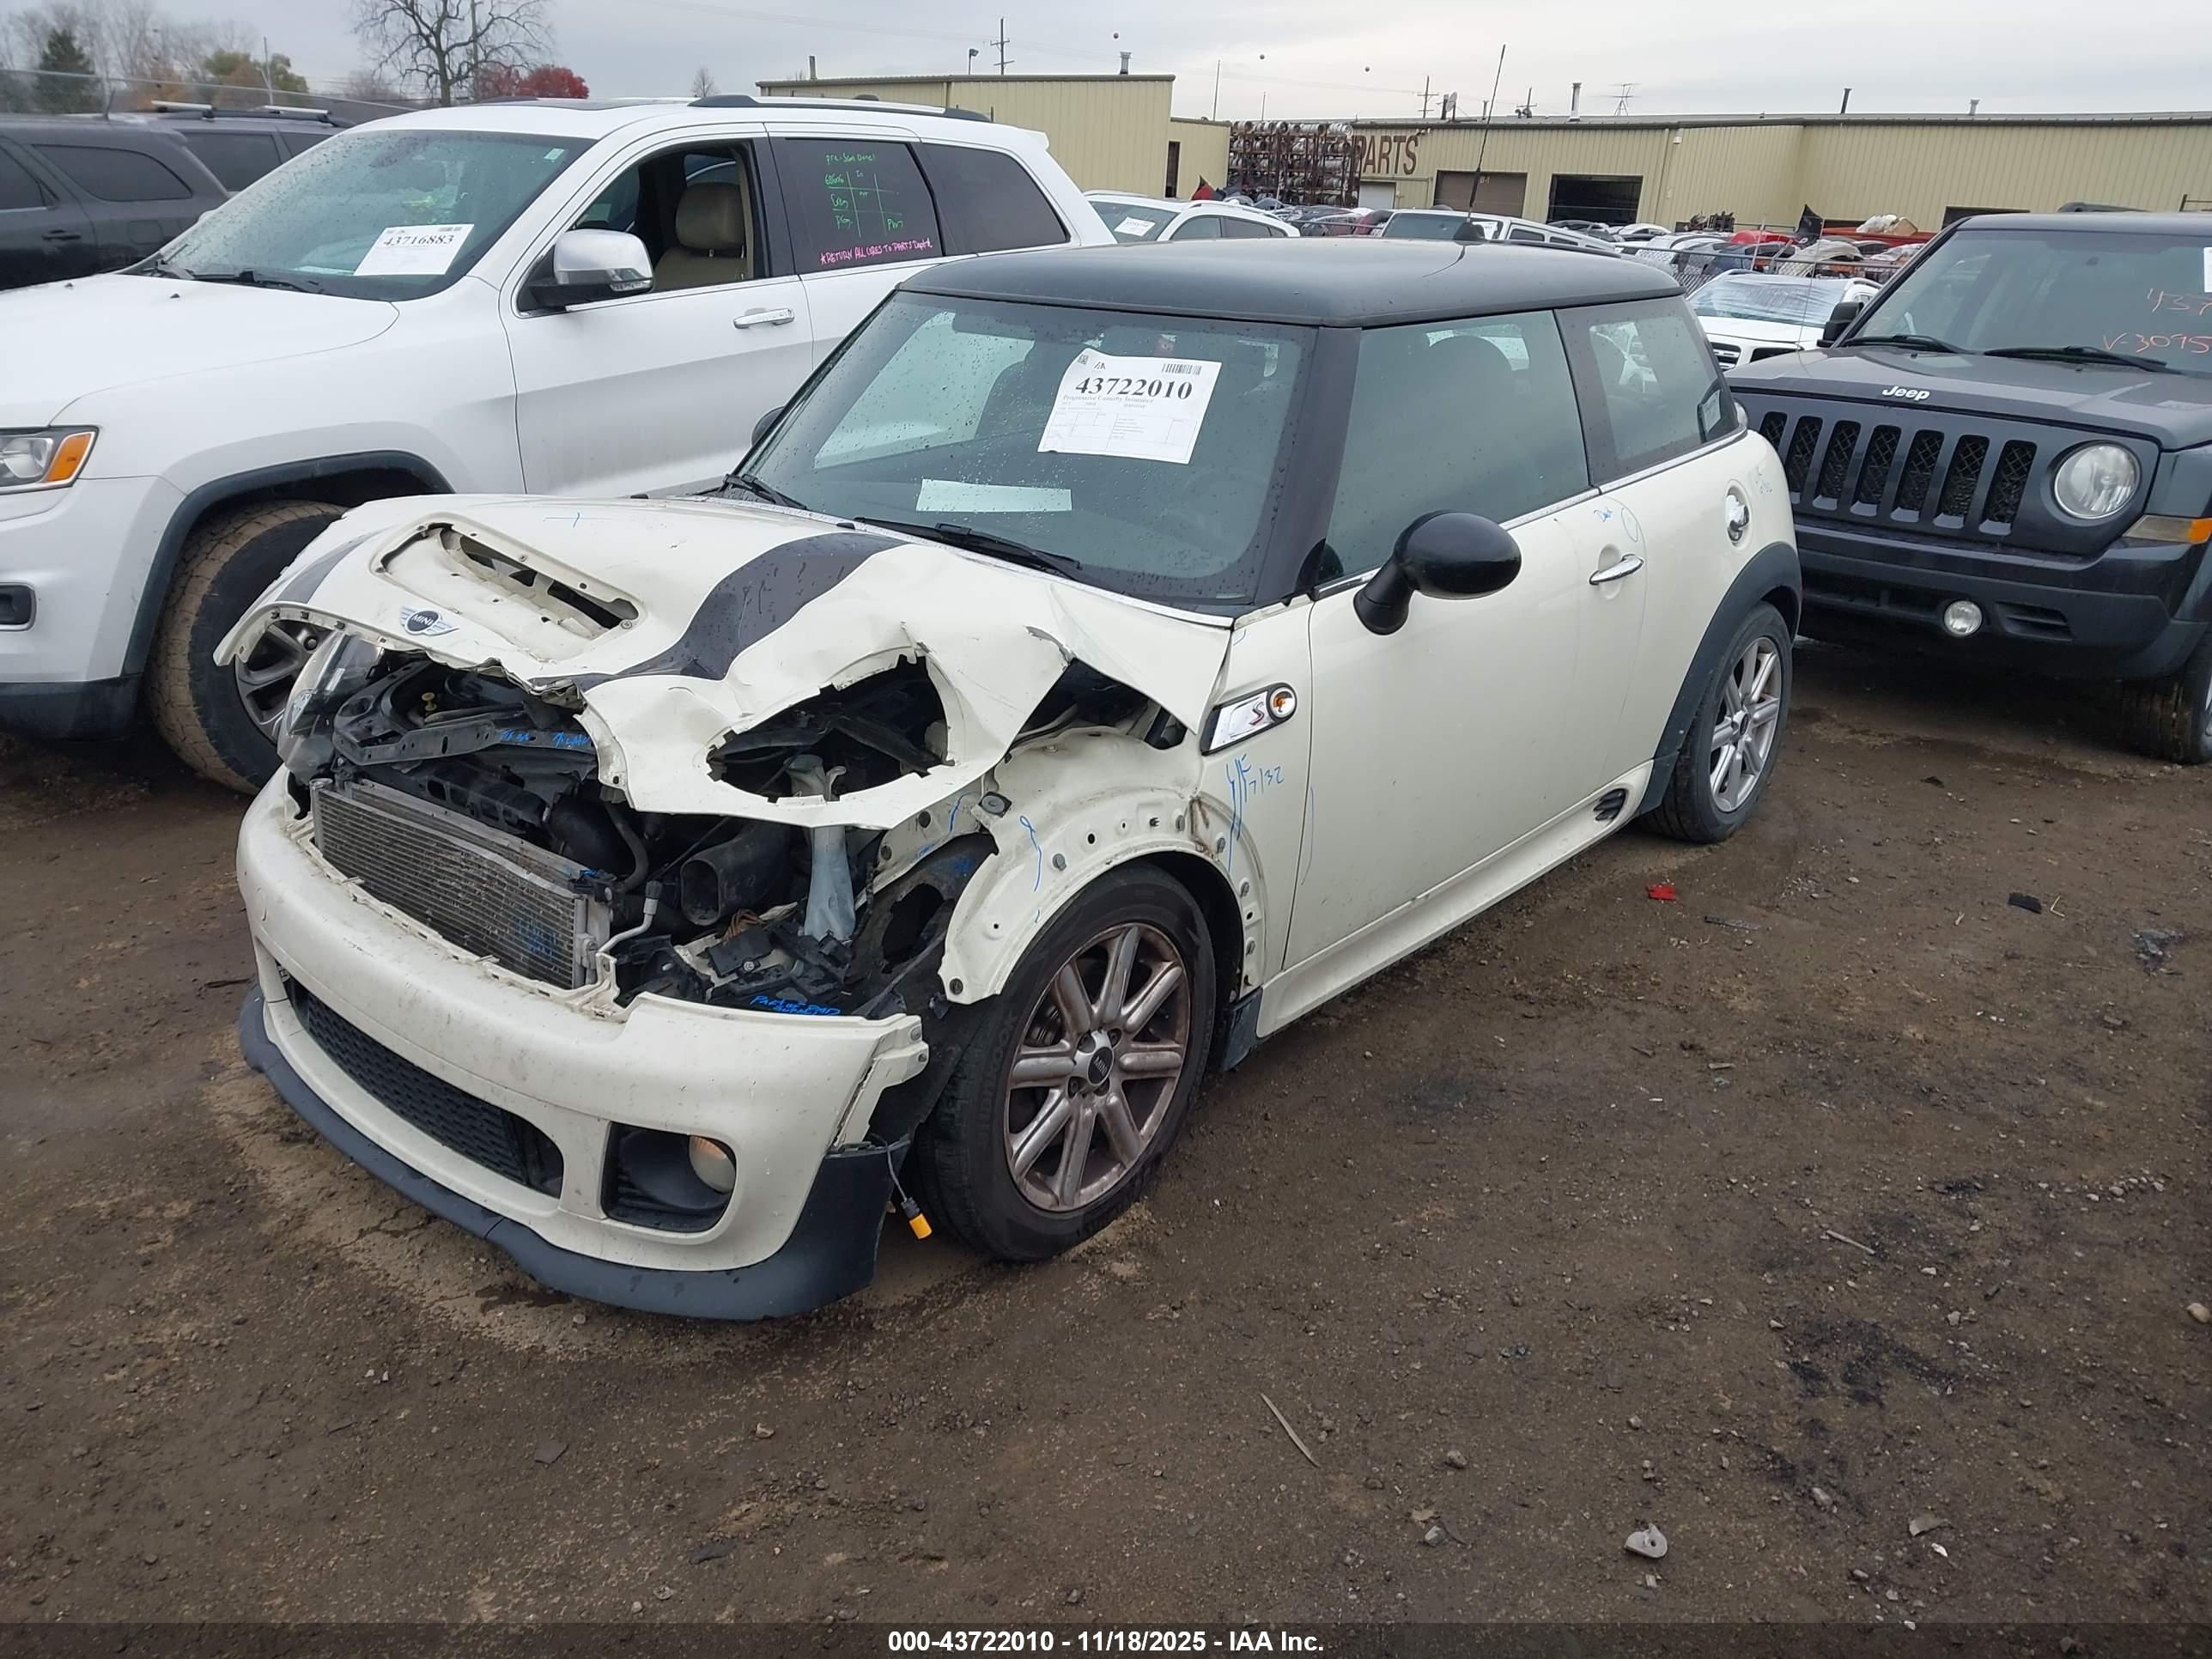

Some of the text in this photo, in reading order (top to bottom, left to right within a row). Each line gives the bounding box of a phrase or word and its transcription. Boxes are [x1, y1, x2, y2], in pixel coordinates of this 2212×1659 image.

[384, 234, 454, 246] 43716883
[854, 246, 866, 259] ALL
[892, 241, 912, 252] PARTS
[1075, 377, 1193, 399] 43722010
[1882, 386, 1930, 401] Jeep
[411, 614, 434, 626] MINI
